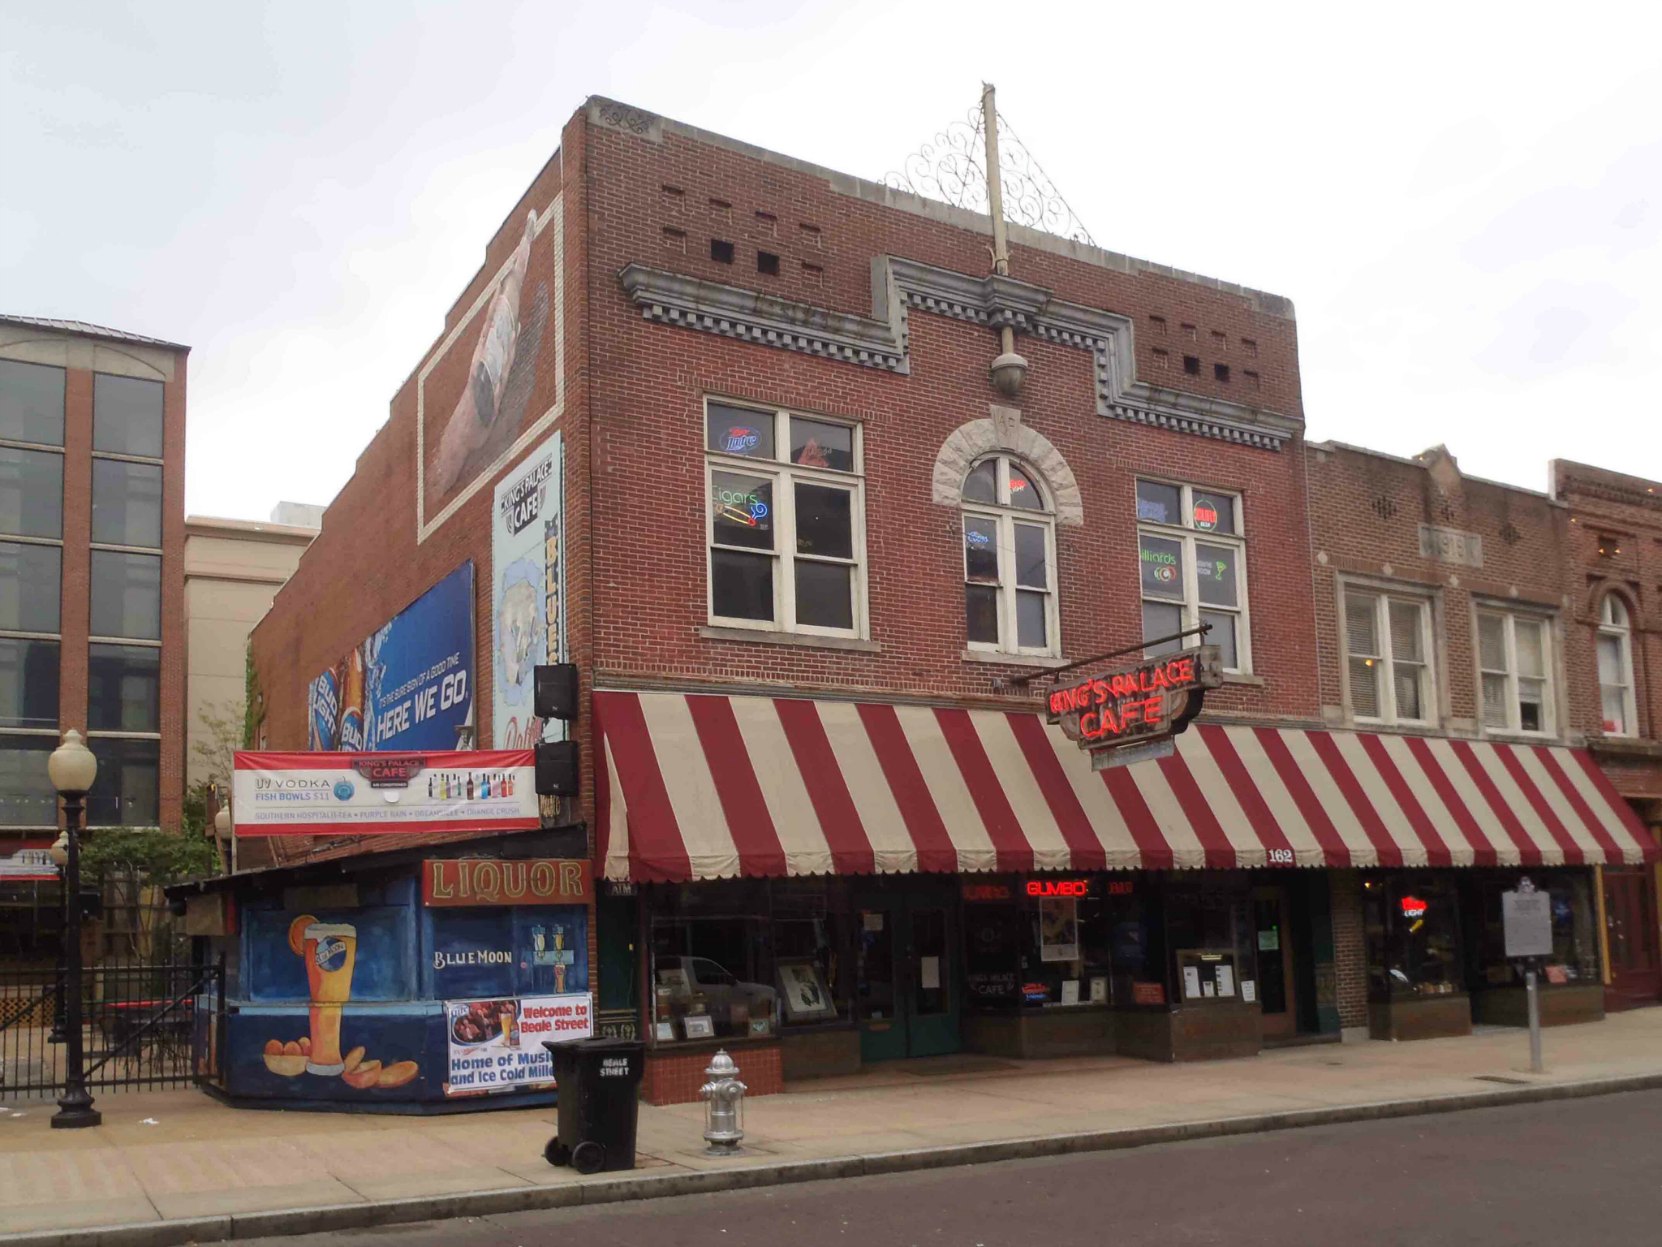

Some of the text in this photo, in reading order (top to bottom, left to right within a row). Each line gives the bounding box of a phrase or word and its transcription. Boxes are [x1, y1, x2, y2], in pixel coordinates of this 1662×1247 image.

[525, 461, 549, 493] PALACE
[514, 492, 538, 529] CAFE
[430, 660, 446, 679] GOOD
[447, 651, 460, 669] TIME
[1050, 658, 1195, 714] KING'S PALACE
[318, 675, 338, 718] BUD
[314, 695, 337, 736] LIGHT
[376, 700, 411, 743] HERE
[415, 685, 438, 724] WE
[1080, 695, 1164, 738] CAFE
[342, 722, 363, 751] BUD
[373, 767, 406, 777] CAFE
[275, 779, 331, 789] VODKA
[255, 793, 277, 801] FISH
[279, 792, 311, 801] BOWLS
[255, 811, 295, 820] SOUTHERN
[360, 809, 387, 818] PURPLE
[467, 807, 494, 816] ORANGE
[496, 806, 519, 816] CRUSH
[1268, 849, 1293, 862] 162
[433, 862, 583, 902] LIQUOR
[611, 885, 631, 895] ATM
[1026, 880, 1086, 896] GUMBO
[433, 950, 512, 969] BLUE MOON
[979, 985, 1005, 994] CAFE
[523, 1004, 587, 1019] Welcome to
[521, 1017, 589, 1033] Beale Street
[451, 1056, 493, 1070] Home
[497, 1053, 513, 1067] of
[602, 1058, 628, 1067] BEALE
[451, 1071, 474, 1085] and
[478, 1069, 496, 1082] Ice
[500, 1066, 525, 1080] Cold
[600, 1067, 630, 1076] STREET
